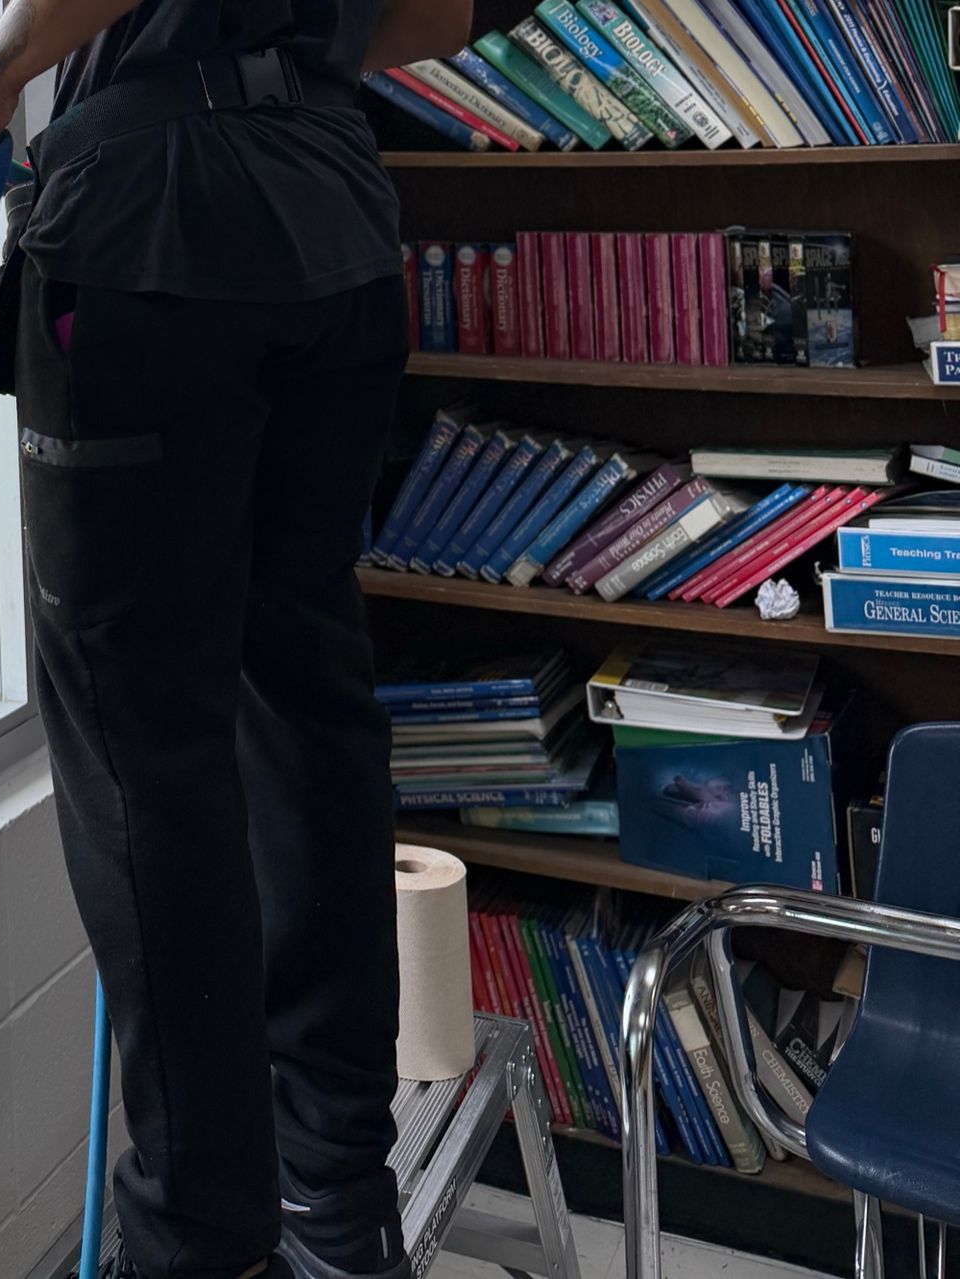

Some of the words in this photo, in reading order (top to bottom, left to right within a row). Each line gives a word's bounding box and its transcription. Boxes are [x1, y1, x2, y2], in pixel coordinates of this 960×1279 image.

[558, 9, 604, 61] Biology
[613, 20, 668, 77] BIOLOGY
[461, 267, 471, 330] Dictionary
[497, 268, 507, 331] Dictionary
[578, 464, 621, 514] Physics
[616, 472, 668, 517] PHYSICS
[627, 525, 645, 541] Our
[661, 526, 688, 551] Earth
[629, 543, 666, 573] Science
[890, 547, 941, 560] Teaching
[864, 600, 926, 623] GENERAL
[874, 590, 909, 599] TEACHER
[911, 592, 951, 601] RESOURCE
[400, 792, 454, 805] PHYSICAL
[455, 790, 505, 803] SCIENCE
[748, 771, 756, 789] Skills
[770, 763, 779, 798] Organizers
[740, 792, 750, 832] Improve
[750, 790, 758, 810] Study
[758, 782, 772, 844] FOLDABLES
[771, 799, 780, 825] Graphic
[752, 826, 760, 852] Reading
[773, 826, 782, 862] Interactive
[690, 1046, 717, 1079] Earth
[702, 1078, 737, 1125] Science
[411, 1243, 426, 1272] ING
[424, 1177, 457, 1243] PLATFORM
[417, 1235, 439, 1279] STOOL
